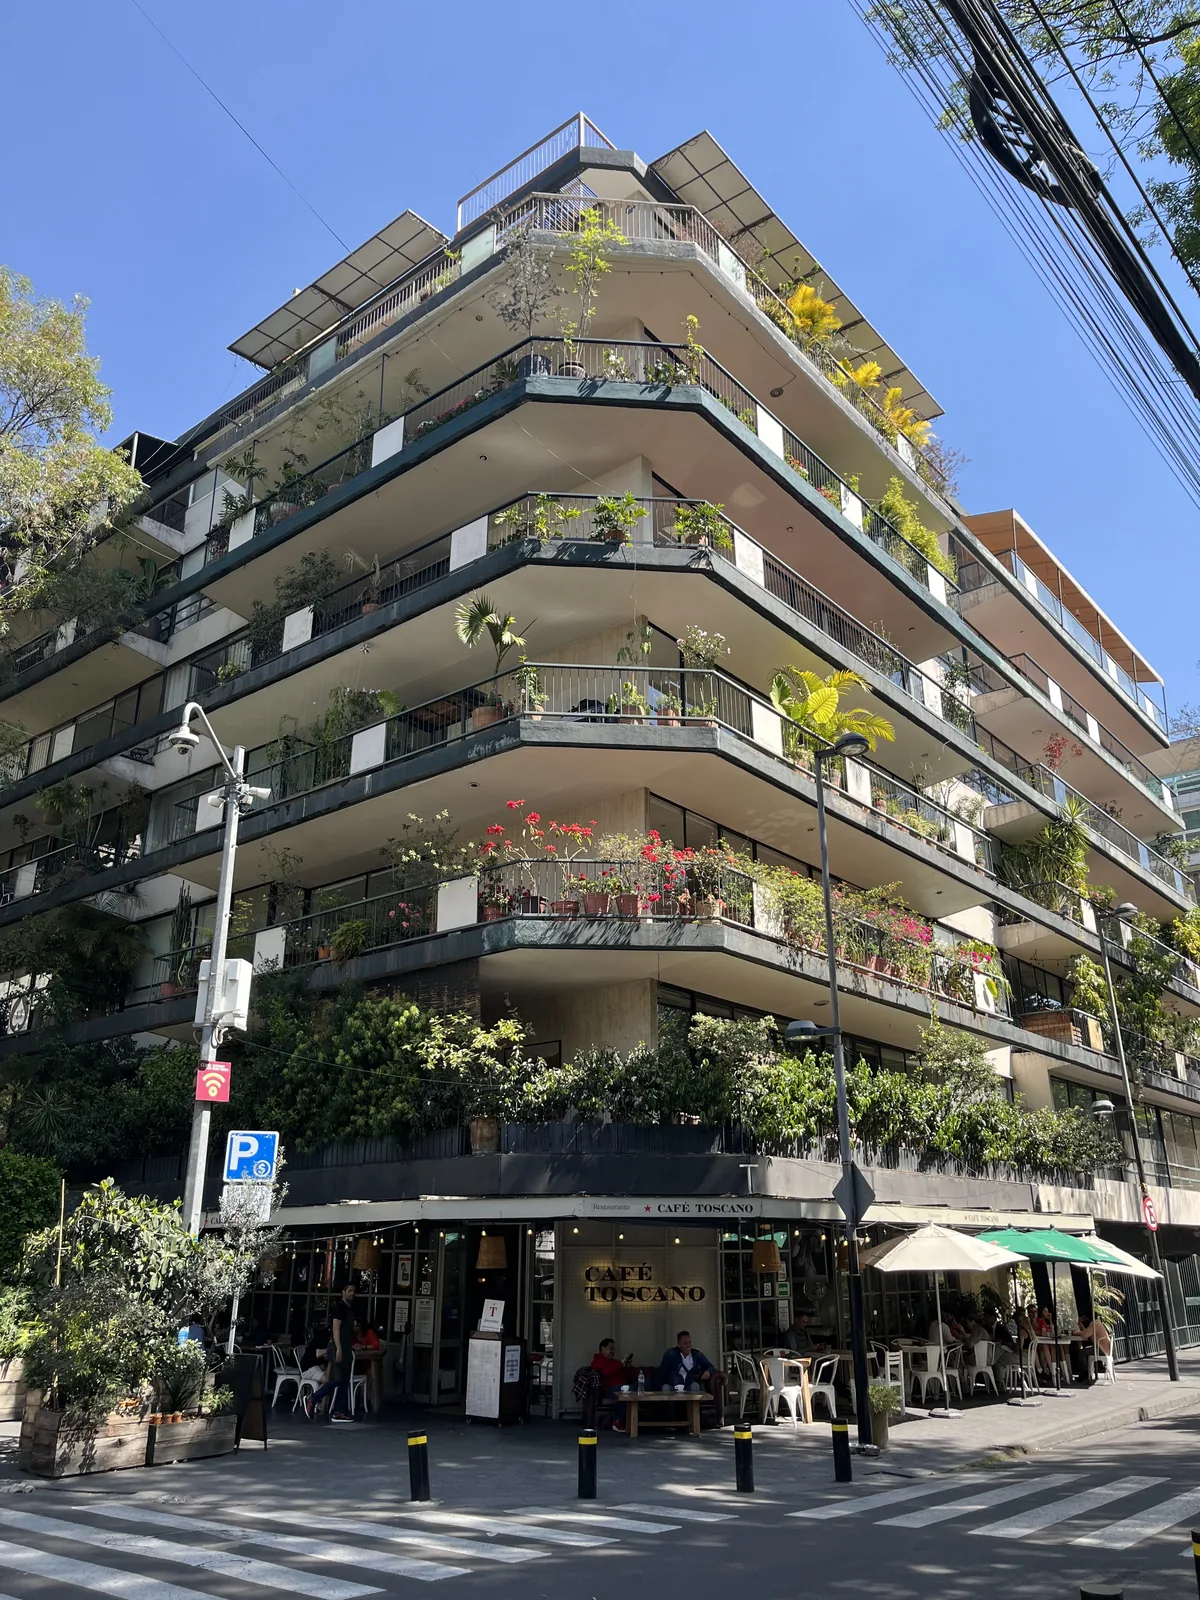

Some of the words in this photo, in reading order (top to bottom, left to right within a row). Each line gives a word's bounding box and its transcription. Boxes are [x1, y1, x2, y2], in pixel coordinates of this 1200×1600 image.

[229, 1135, 259, 1170] P
[592, 1203, 631, 1212] Restaurante
[657, 1202, 690, 1213] CAFÉ
[695, 1203, 754, 1213] TOSCANO
[585, 1263, 652, 1282] CAFÉ
[584, 1286, 706, 1302] TOSCANO
[489, 1306, 498, 1317] T
